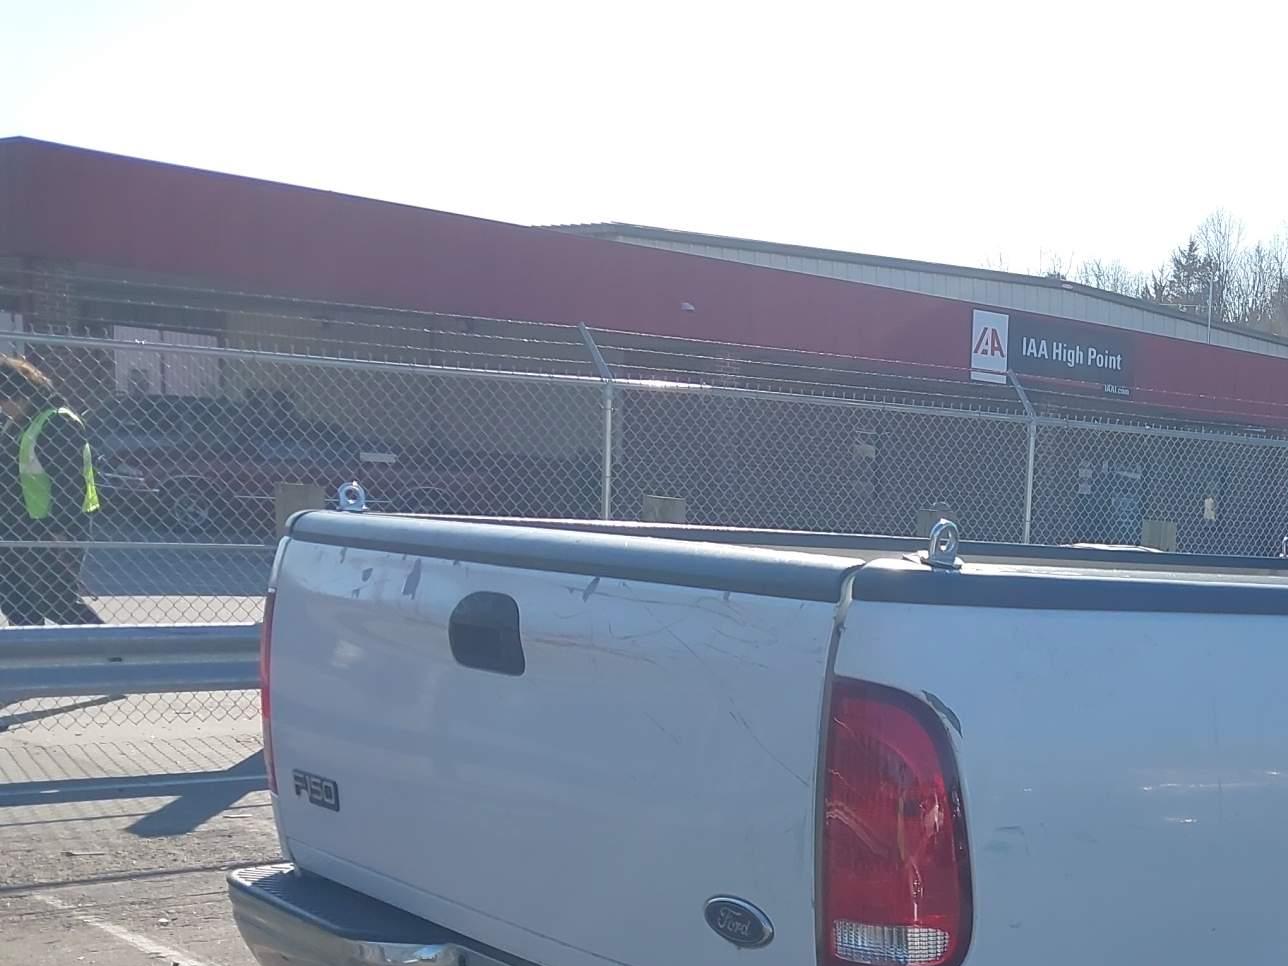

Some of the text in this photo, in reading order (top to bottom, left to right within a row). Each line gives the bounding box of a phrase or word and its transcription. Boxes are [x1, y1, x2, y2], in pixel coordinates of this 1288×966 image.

[1022, 336, 1122, 371] IAA High Point
[717, 906, 752, 937] Ford
